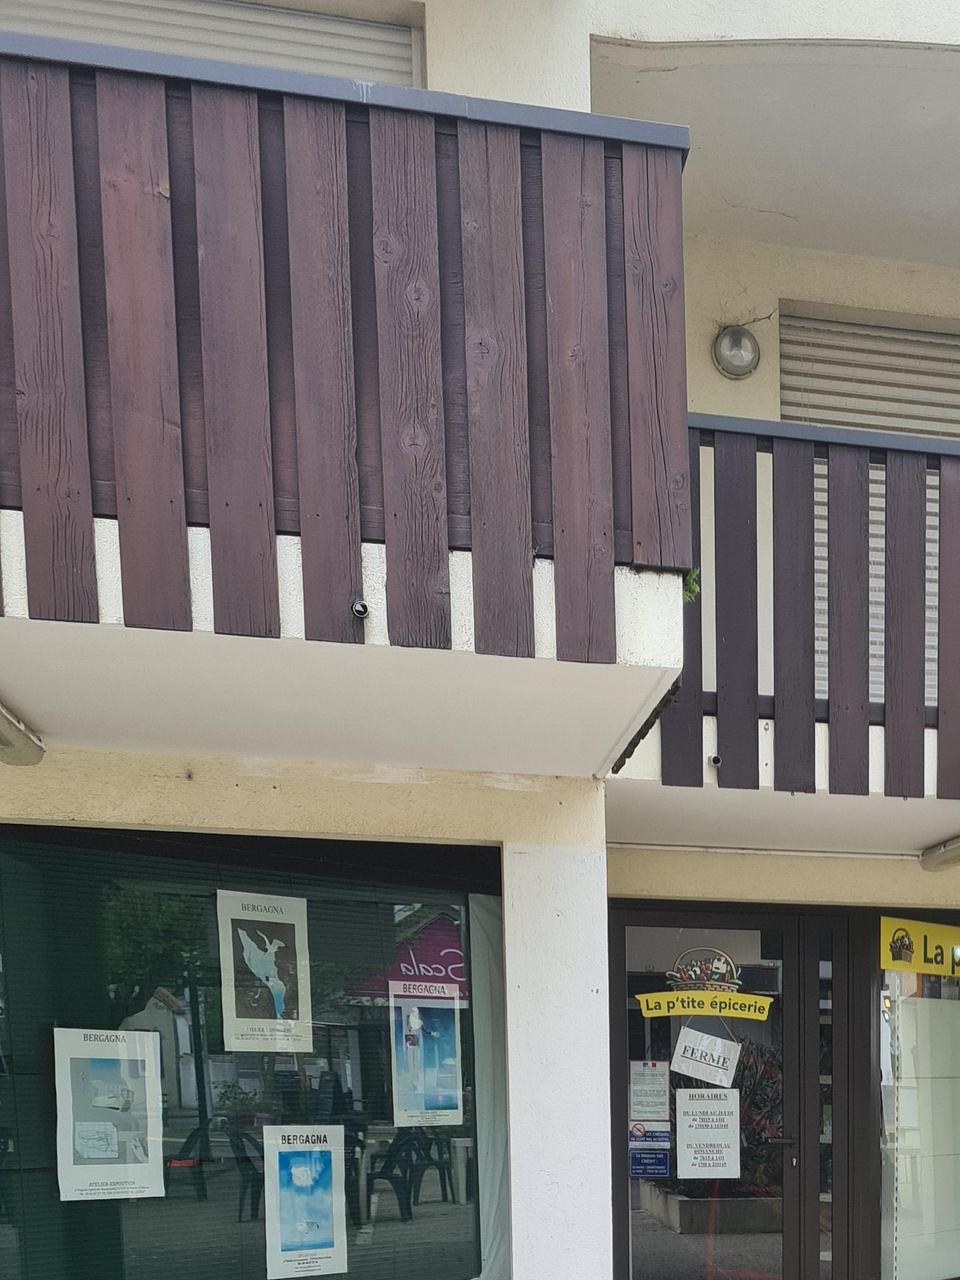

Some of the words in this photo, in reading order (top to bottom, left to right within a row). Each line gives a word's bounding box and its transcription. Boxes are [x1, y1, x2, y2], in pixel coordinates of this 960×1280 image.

[241, 903, 284, 915] BERGAGNA
[923, 934, 944, 966] La
[402, 983, 447, 995] BERGAGNA
[645, 998, 662, 1012] La
[666, 996, 705, 1013] p'tite
[709, 995, 766, 1014] épicerie
[83, 1033, 127, 1043] BERGAGNA
[281, 1134, 328, 1145] BERGAGNA
